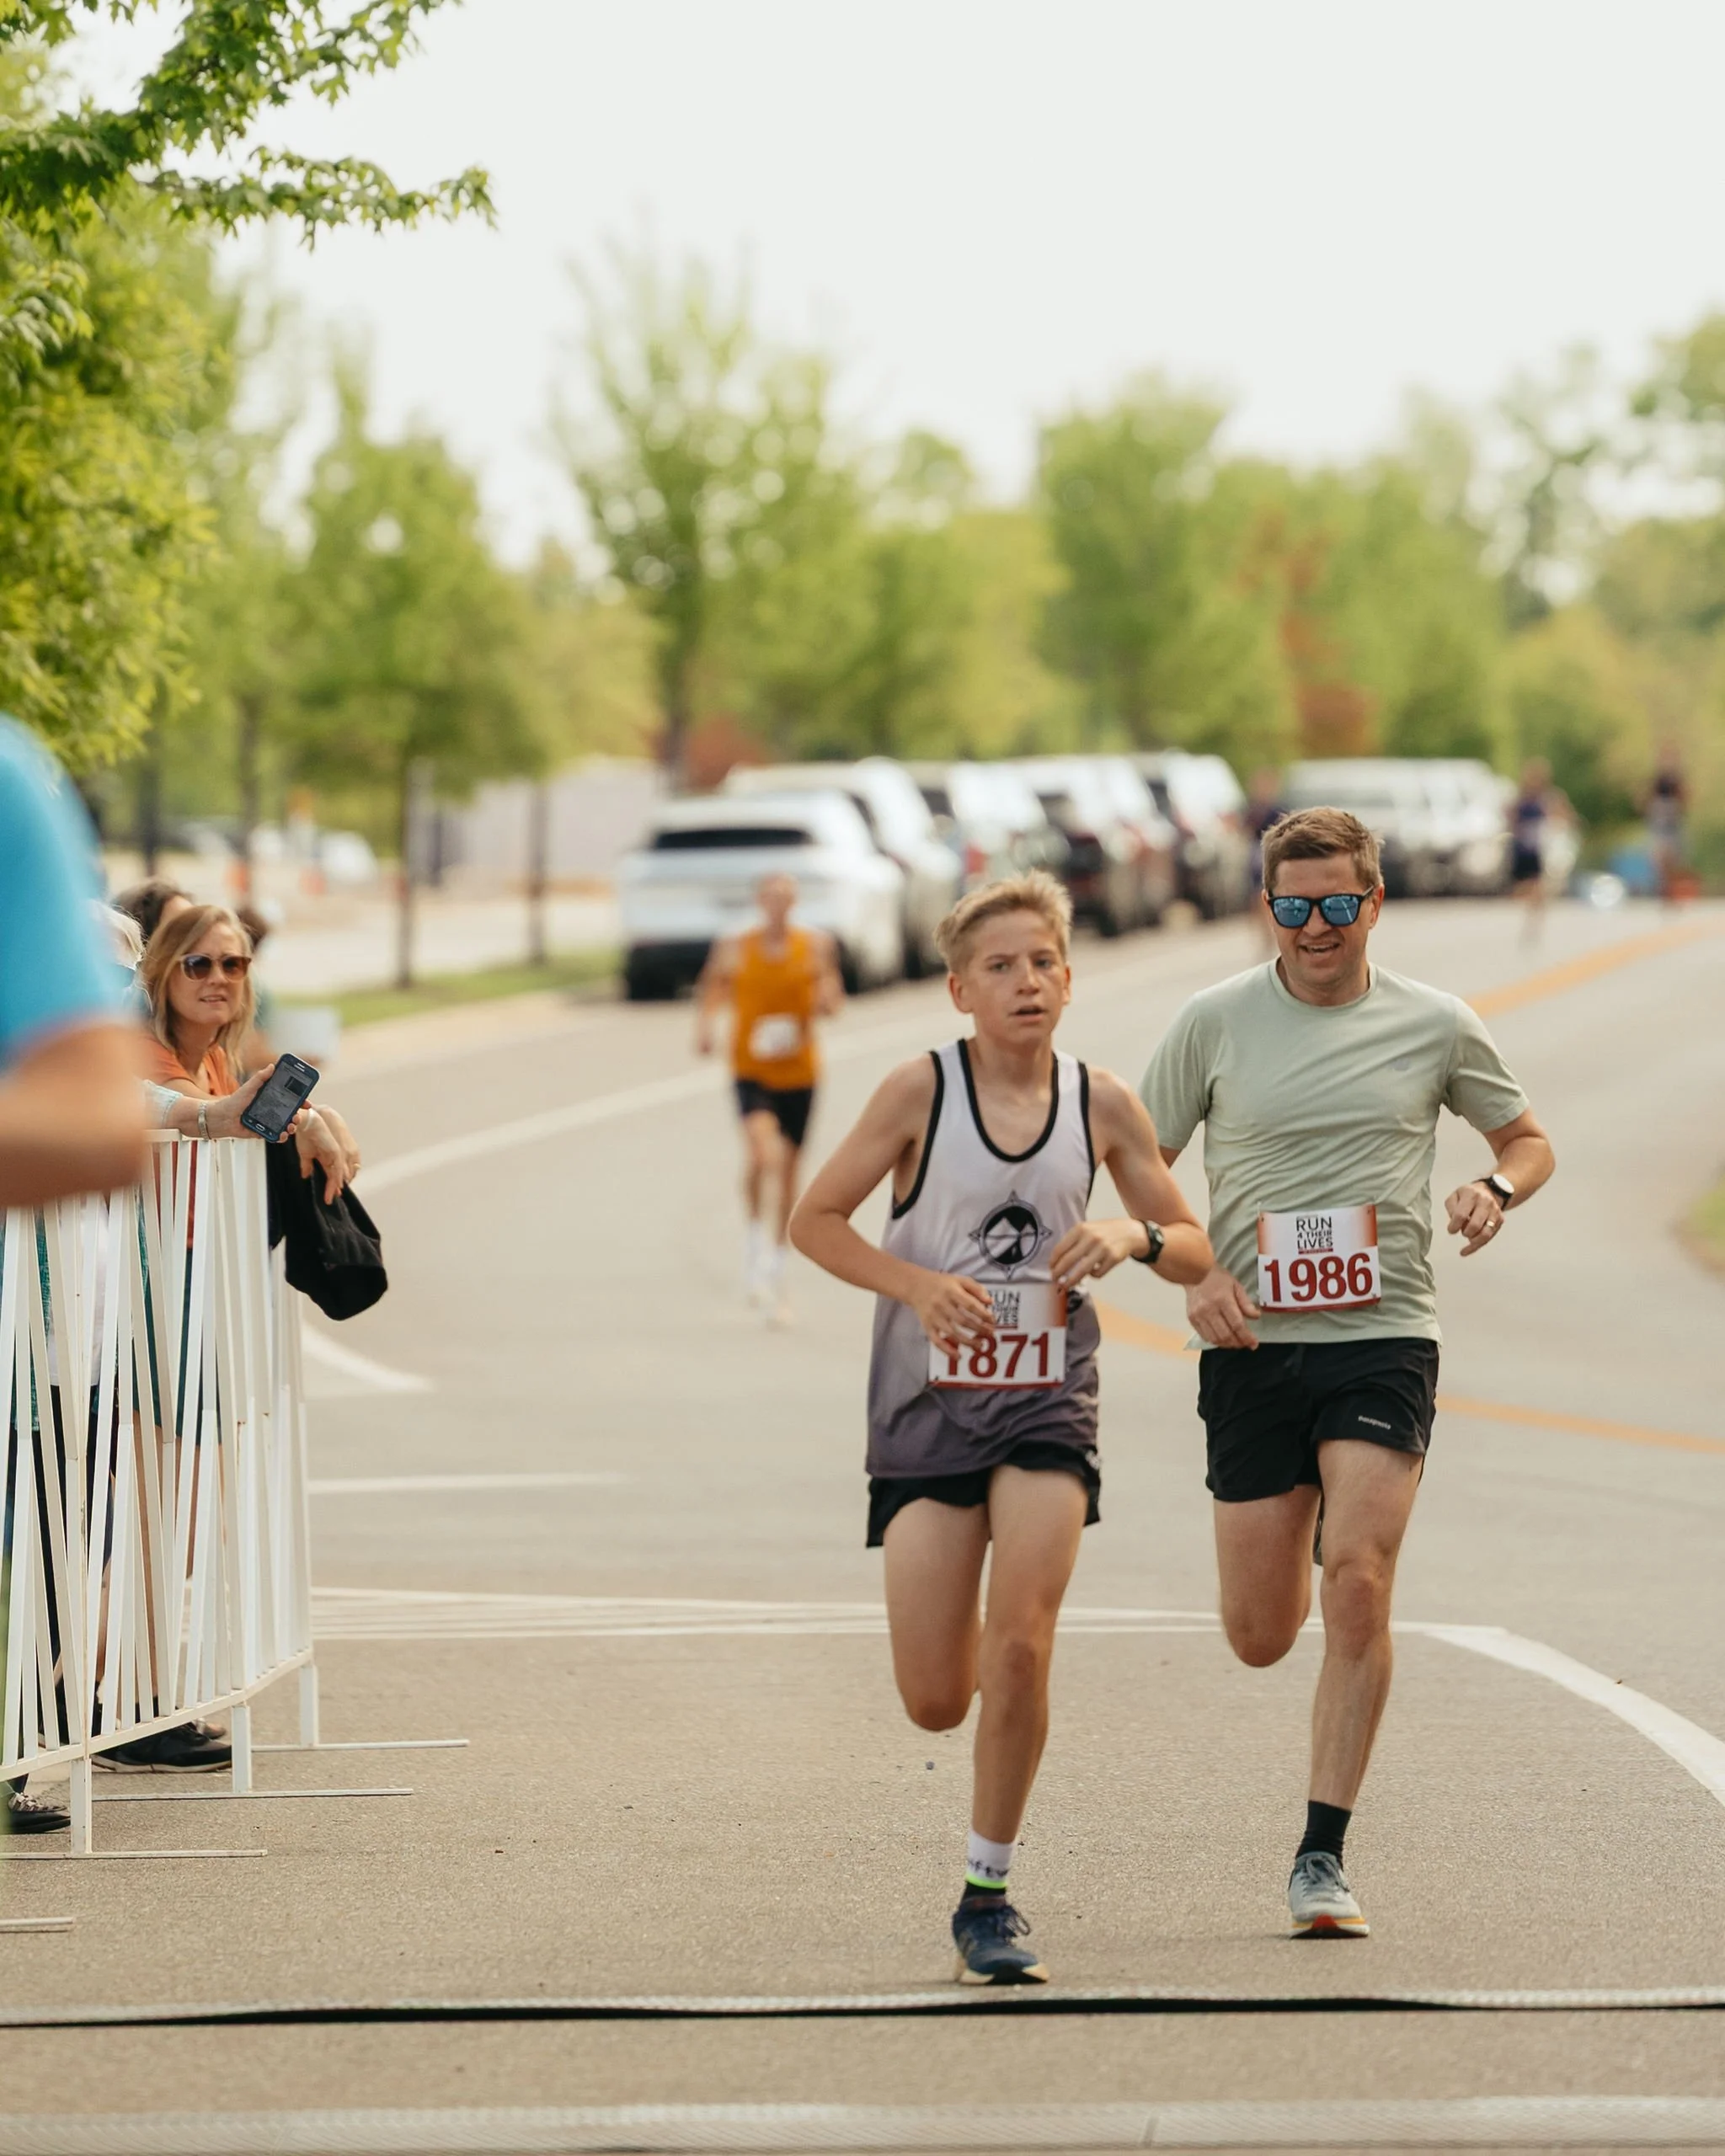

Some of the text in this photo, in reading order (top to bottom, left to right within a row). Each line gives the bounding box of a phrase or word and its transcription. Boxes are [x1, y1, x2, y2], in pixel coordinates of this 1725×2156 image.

[1296, 1216, 1332, 1231] RUN
[1306, 1230, 1332, 1238] THEIR
[1297, 1237, 1333, 1249] LIVES
[1264, 1252, 1373, 1302] 1986
[987, 1289, 1021, 1305] UN
